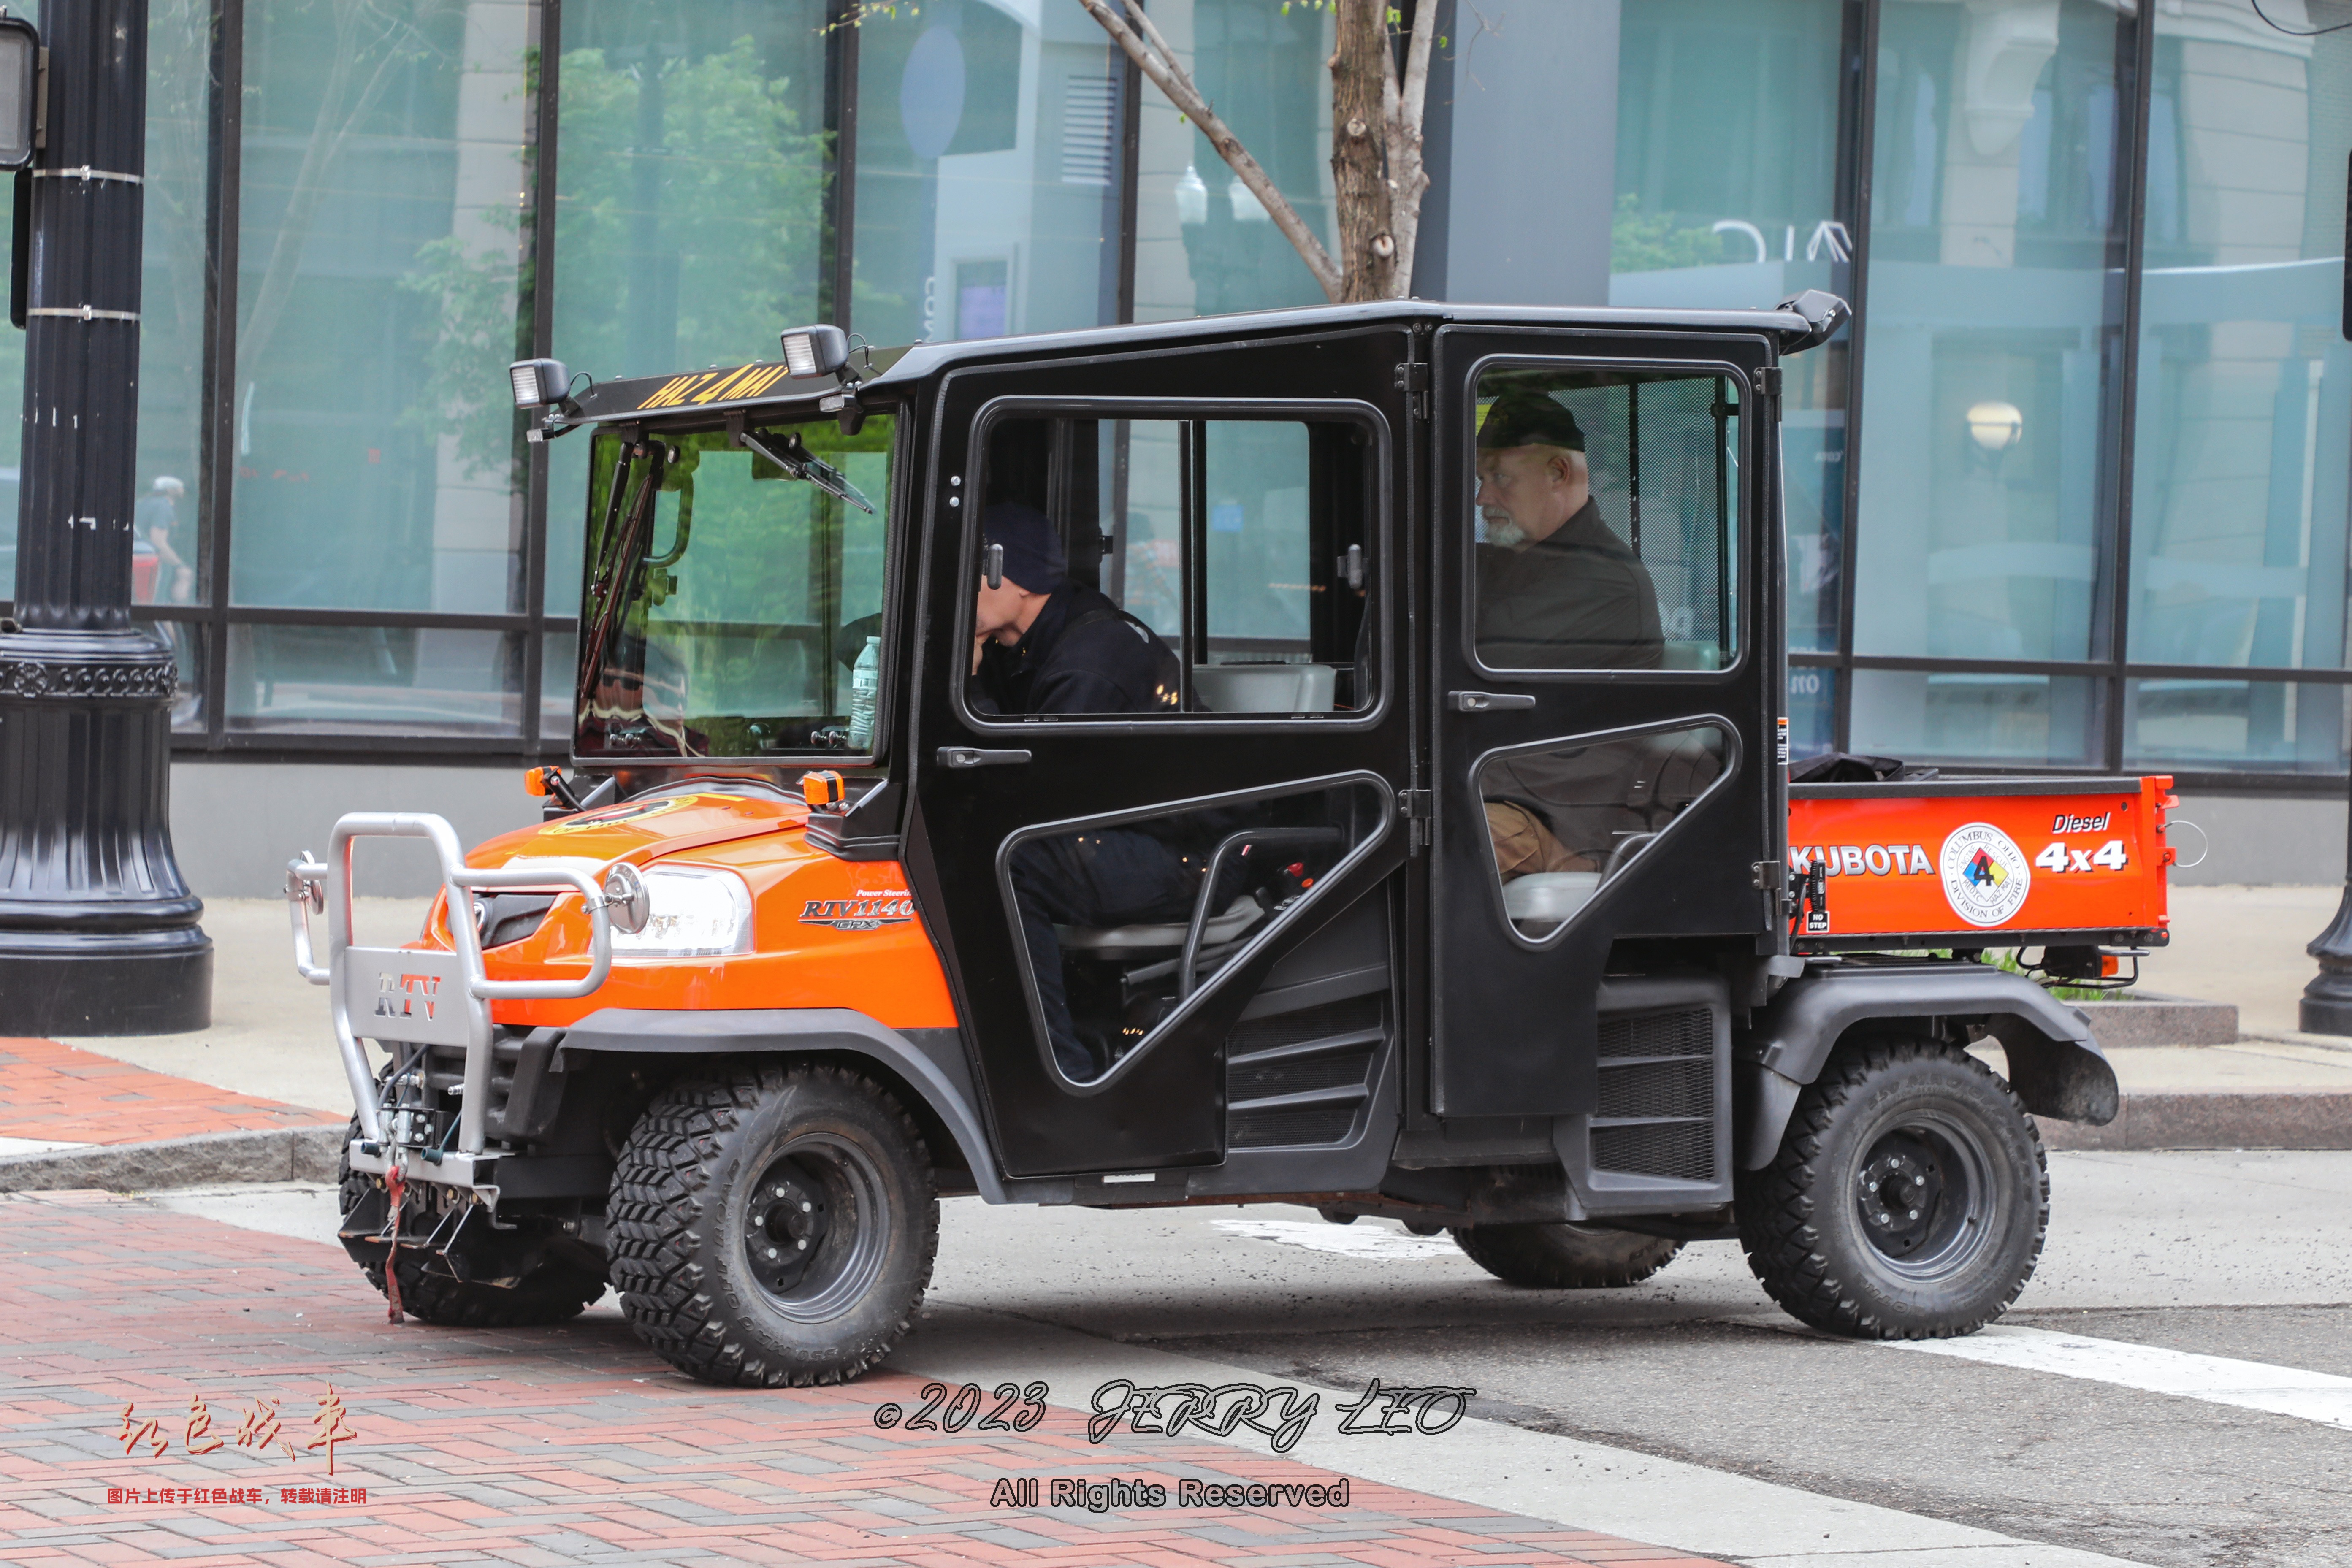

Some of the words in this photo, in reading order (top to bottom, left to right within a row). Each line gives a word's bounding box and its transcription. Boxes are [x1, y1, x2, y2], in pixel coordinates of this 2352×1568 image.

[637, 372, 718, 409] HAZ
[690, 363, 754, 406] 4
[2052, 811, 2111, 834] Diesel
[1789, 845, 1935, 877] KUBOTA
[1947, 831, 1994, 869] COLUMBUS
[1998, 840, 2021, 869] OHIO
[1959, 845, 1977, 870] ENGINE
[1983, 844, 2009, 868] RESCUE
[2035, 840, 2129, 874] 4x4
[1973, 856, 1995, 886] 4
[1951, 879, 1988, 918] DIVISION
[1992, 905, 2005, 918] OF
[2007, 878, 2023, 907] FIRE
[1963, 879, 1983, 902] MEDIC
[1990, 889, 2002, 905] HAZ
[2001, 877, 2013, 891] MAT
[799, 899, 915, 917] RTV1140
[1809, 921, 1827, 929] STEP
[374, 972, 441, 1021] RTV
